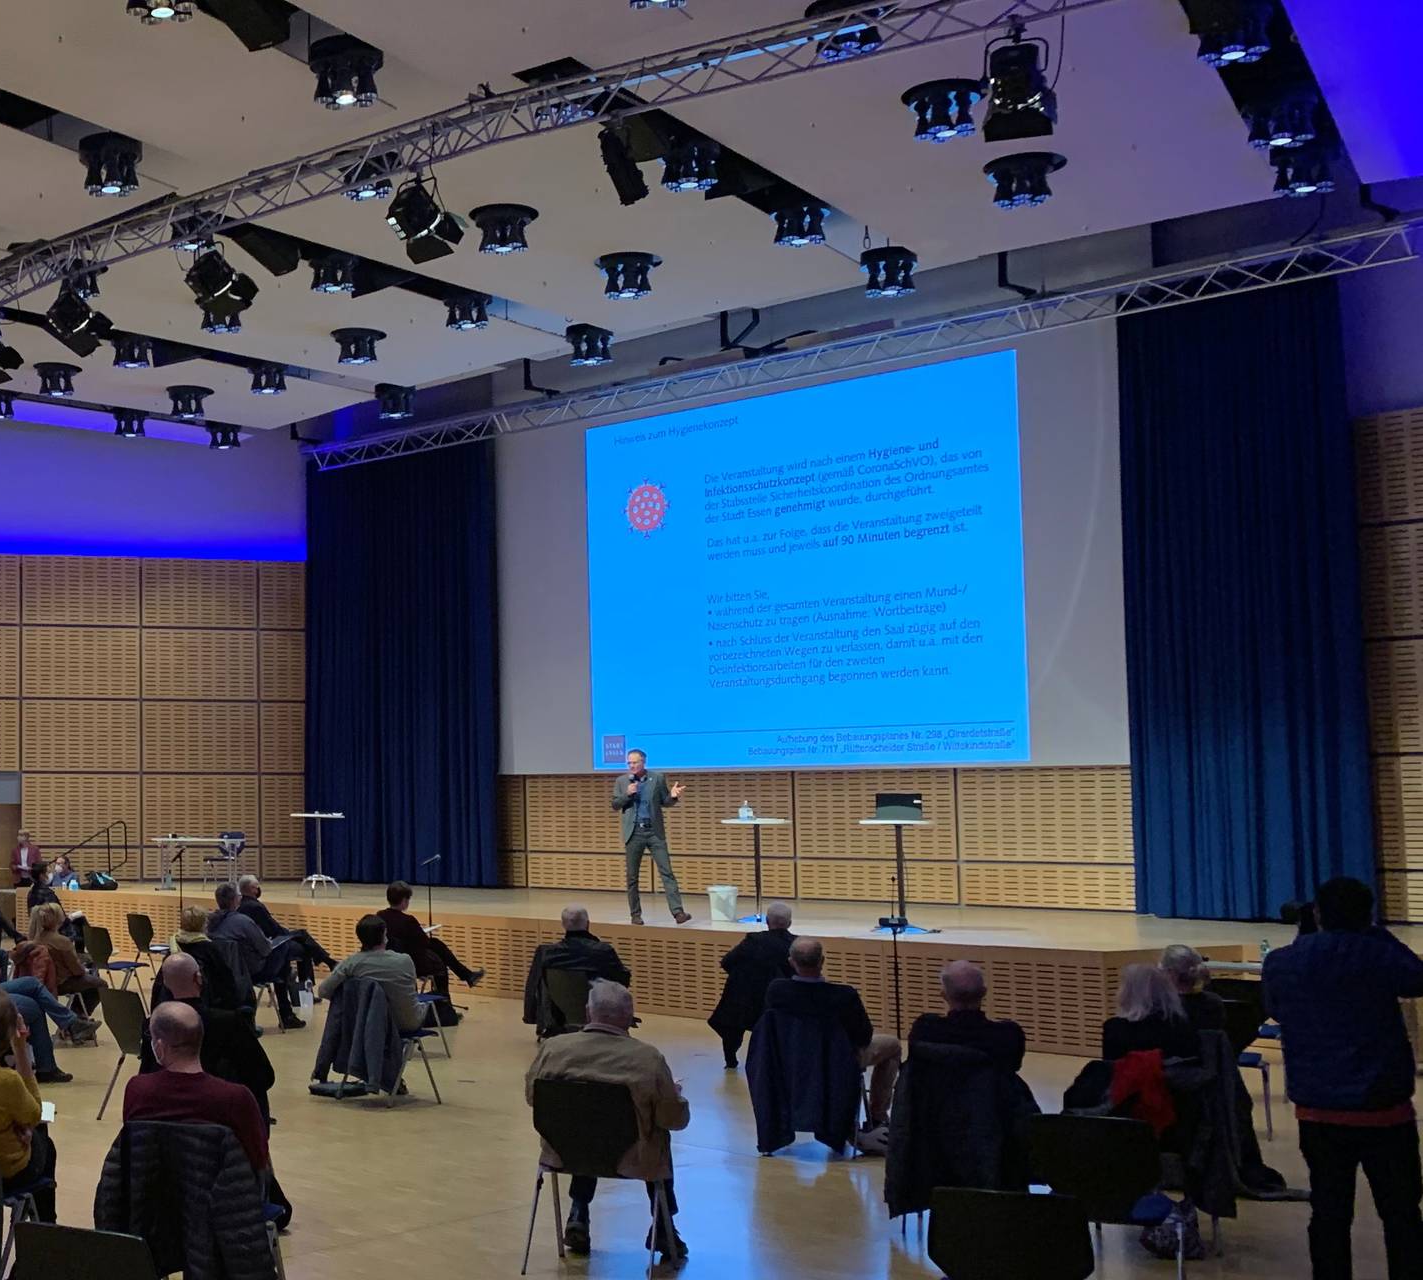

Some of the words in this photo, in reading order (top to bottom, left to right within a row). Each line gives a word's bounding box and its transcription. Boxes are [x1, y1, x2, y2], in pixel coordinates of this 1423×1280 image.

[648, 430, 666, 439] zum
[668, 416, 739, 438] Hygienekonzept
[704, 473, 719, 484] Die
[721, 464, 785, 481] Veranstaltung
[786, 459, 807, 471] wird
[810, 453, 833, 468] nach
[836, 451, 865, 464] einem
[868, 445, 915, 460] Hygiene-
[918, 437, 939, 451] und
[704, 473, 815, 497] Infektionsschutzkonzept
[818, 465, 854, 482] (gemäß
[857, 455, 937, 475] CoronaSchVO),
[940, 451, 959, 463] das
[962, 449, 982, 459] von
[704, 500, 719, 510] der
[721, 495, 768, 508] Stabsstelle
[770, 477, 881, 501] Sicherheitskoordination
[884, 474, 901, 485] des
[905, 463, 990, 482] Ordnungsamtes
[704, 513, 719, 524] der
[721, 510, 745, 522] Stadt
[747, 507, 772, 518] Essen
[774, 499, 825, 517] genehmigt
[707, 537, 723, 548] Das
[726, 535, 741, 545] hat
[763, 531, 777, 541] zur
[811, 523, 831, 535] dass
[834, 521, 849, 532] die
[852, 513, 922, 529] Veranstaltung
[925, 504, 982, 521] zweigeteilt
[707, 549, 740, 560] werden
[742, 546, 766, 557] muss
[768, 542, 786, 554] und
[788, 539, 821, 554] jeweils
[823, 535, 839, 548] auf
[841, 534, 854, 545] 90
[857, 528, 900, 543] Minuten
[904, 523, 950, 540] begrenzt
[707, 593, 723, 604] Wir
[726, 591, 751, 602] bitten
[715, 605, 754, 617] während
[757, 603, 771, 613] der
[774, 598, 819, 614] gesamten
[822, 592, 891, 607] Veranstaltung
[894, 590, 922, 601] einen
[707, 617, 763, 631] Nasenschutz
[765, 618, 777, 627] zu
[779, 614, 810, 627] tragen
[873, 601, 946, 617] Wortbeiträge)
[708, 646, 781, 661] vorbezeichneten
[784, 645, 818, 657] Wegen
[821, 645, 832, 654] zu
[886, 638, 916, 650] damit
[941, 635, 959, 645] mit
[962, 632, 983, 644] den
[716, 637, 737, 647] nach
[739, 635, 772, 646] Schluss
[774, 633, 790, 643] der
[792, 627, 859, 641] Veranstaltung
[862, 626, 881, 637] den
[884, 623, 905, 635] Saal
[908, 622, 936, 635] zügig
[939, 619, 957, 631] auf
[960, 618, 980, 630] den
[708, 660, 806, 675] Desinfektionsarbeiten
[809, 658, 822, 669] für
[825, 657, 843, 668] den
[846, 655, 885, 667] zweiten
[709, 672, 826, 688] Veranstaltungsdurchgang
[828, 670, 878, 684] begonnen
[881, 666, 919, 679] werden
[748, 746, 806, 756] Bebauungsplan
[906, 741, 936, 752] Straße
[777, 733, 818, 744] Aufhebung
[819, 733, 835, 743] des
[836, 730, 909, 743] Bebauungsplanes
